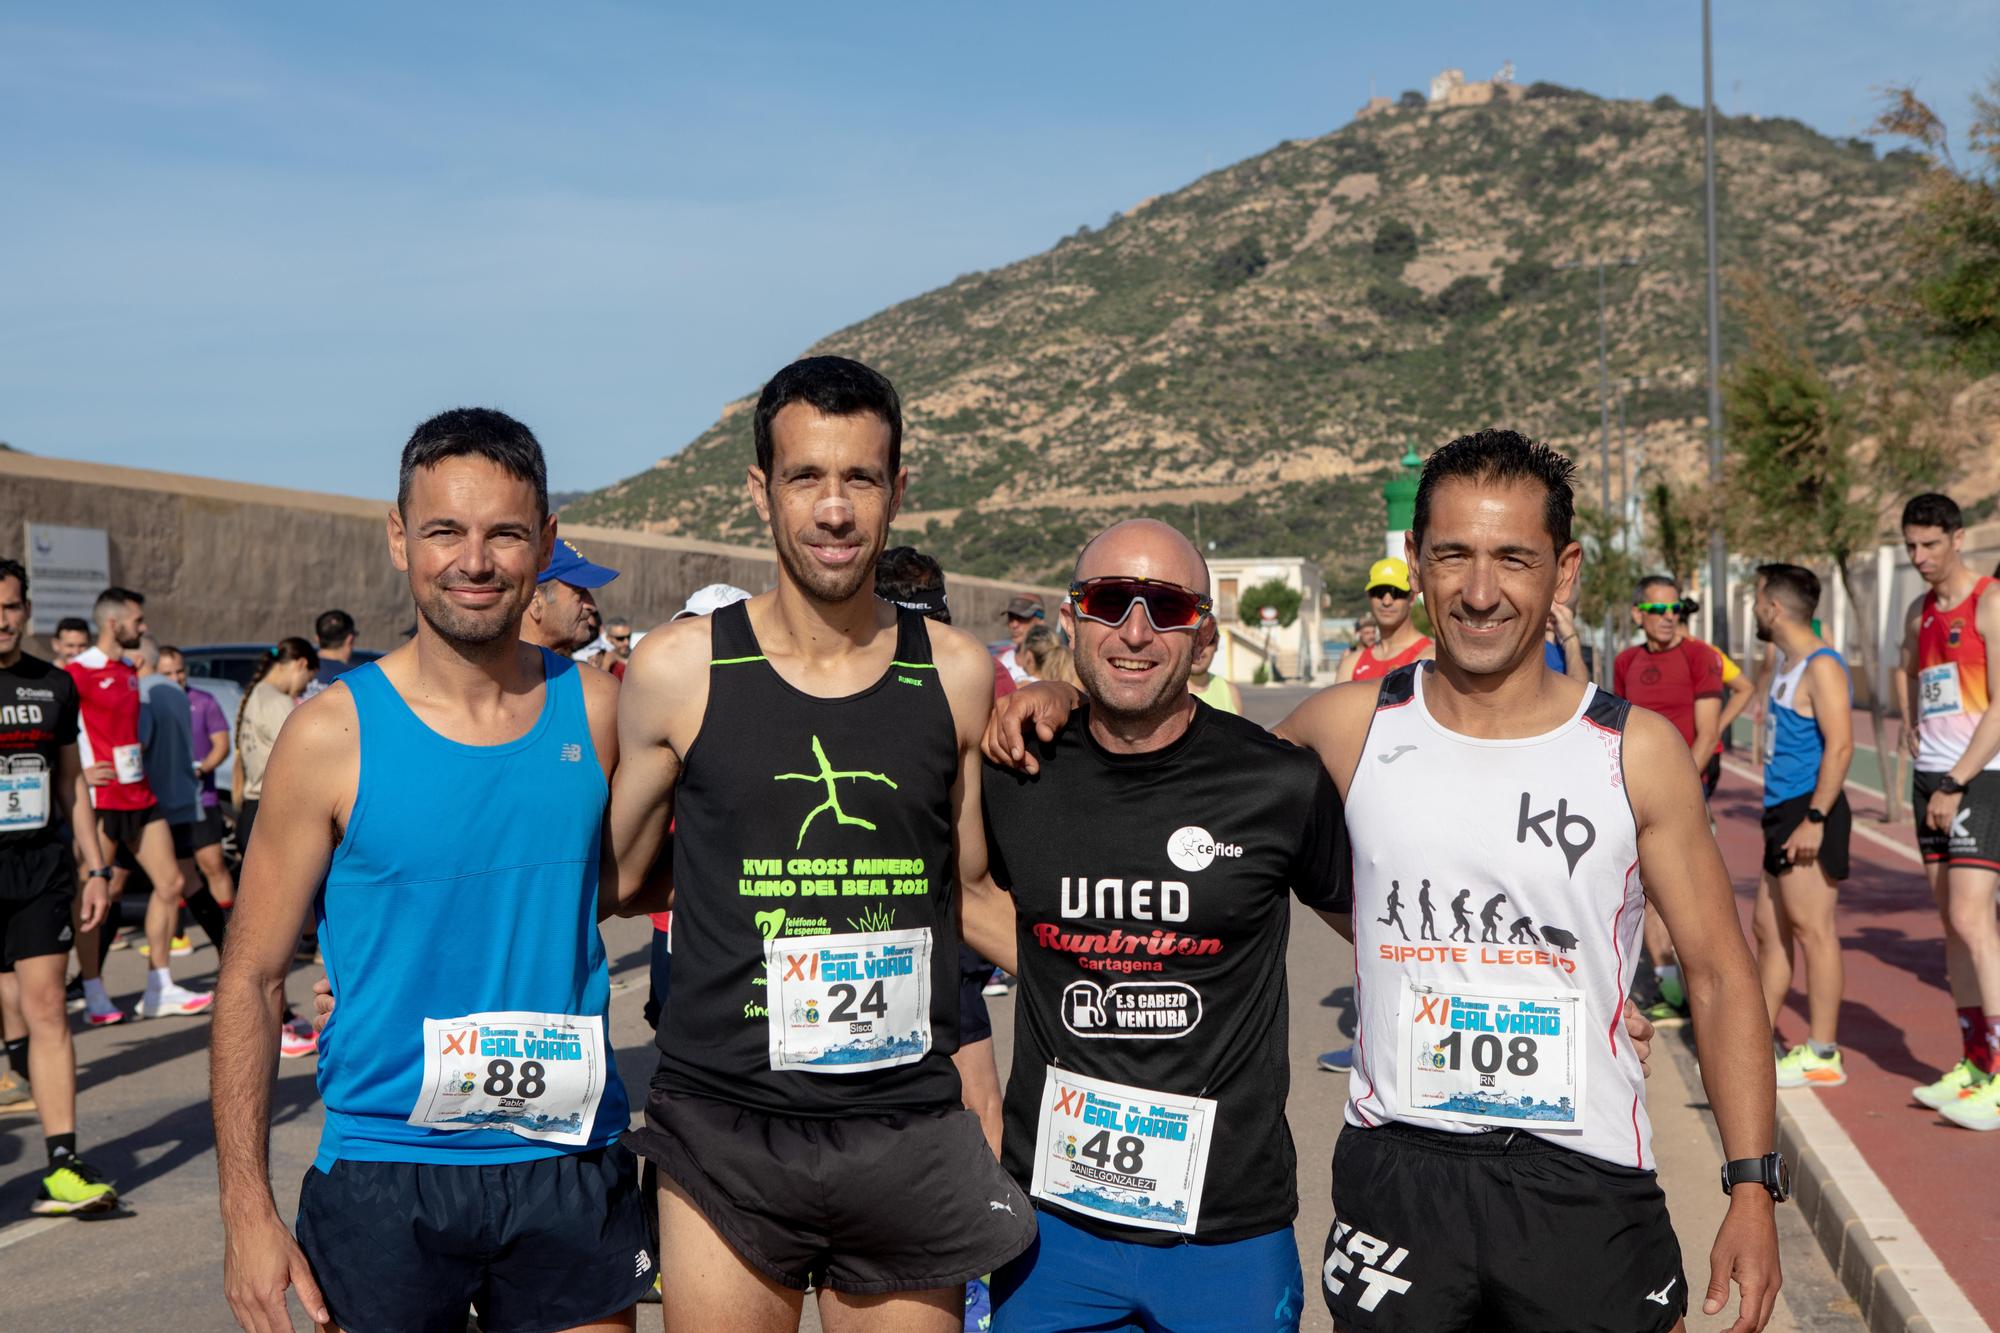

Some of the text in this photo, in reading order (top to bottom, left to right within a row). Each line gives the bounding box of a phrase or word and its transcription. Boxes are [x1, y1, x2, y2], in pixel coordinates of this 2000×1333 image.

[0, 704, 43, 725] NED
[1197, 842, 1243, 858] cefide
[743, 859, 925, 875] XVII CROSS MINERO
[739, 879, 928, 897] LLANO DEL BEAL 2021
[1061, 877, 1190, 922] UNED
[785, 917, 827, 927] Teléfono de
[785, 927, 831, 936] la esperanza
[1033, 923, 1224, 955] Runtriton
[1078, 956, 1163, 974] Cartagena
[1379, 944, 1467, 963] SIPOTE
[783, 953, 819, 982] XI
[821, 955, 913, 983] CALVARIO
[827, 979, 888, 1023] 24
[1116, 993, 1188, 1009] E.S CABEZO
[1414, 996, 1450, 1026] XI
[850, 1023, 873, 1033] Sisco
[1116, 1010, 1188, 1028] VENTURA
[1450, 1009, 1560, 1036] CALVARIO
[442, 1030, 478, 1056] XI
[480, 1037, 582, 1060] CALVARIO
[1439, 1031, 1539, 1077] 108
[483, 1059, 546, 1099] 88
[1480, 1075, 1495, 1086] RN
[499, 1098, 525, 1108] Pablo
[1053, 1086, 1086, 1119] XI
[1082, 1104, 1188, 1141] CALVARIO
[1081, 1130, 1145, 1175] 48
[1070, 1162, 1157, 1191] DANIELGONZALEZT
